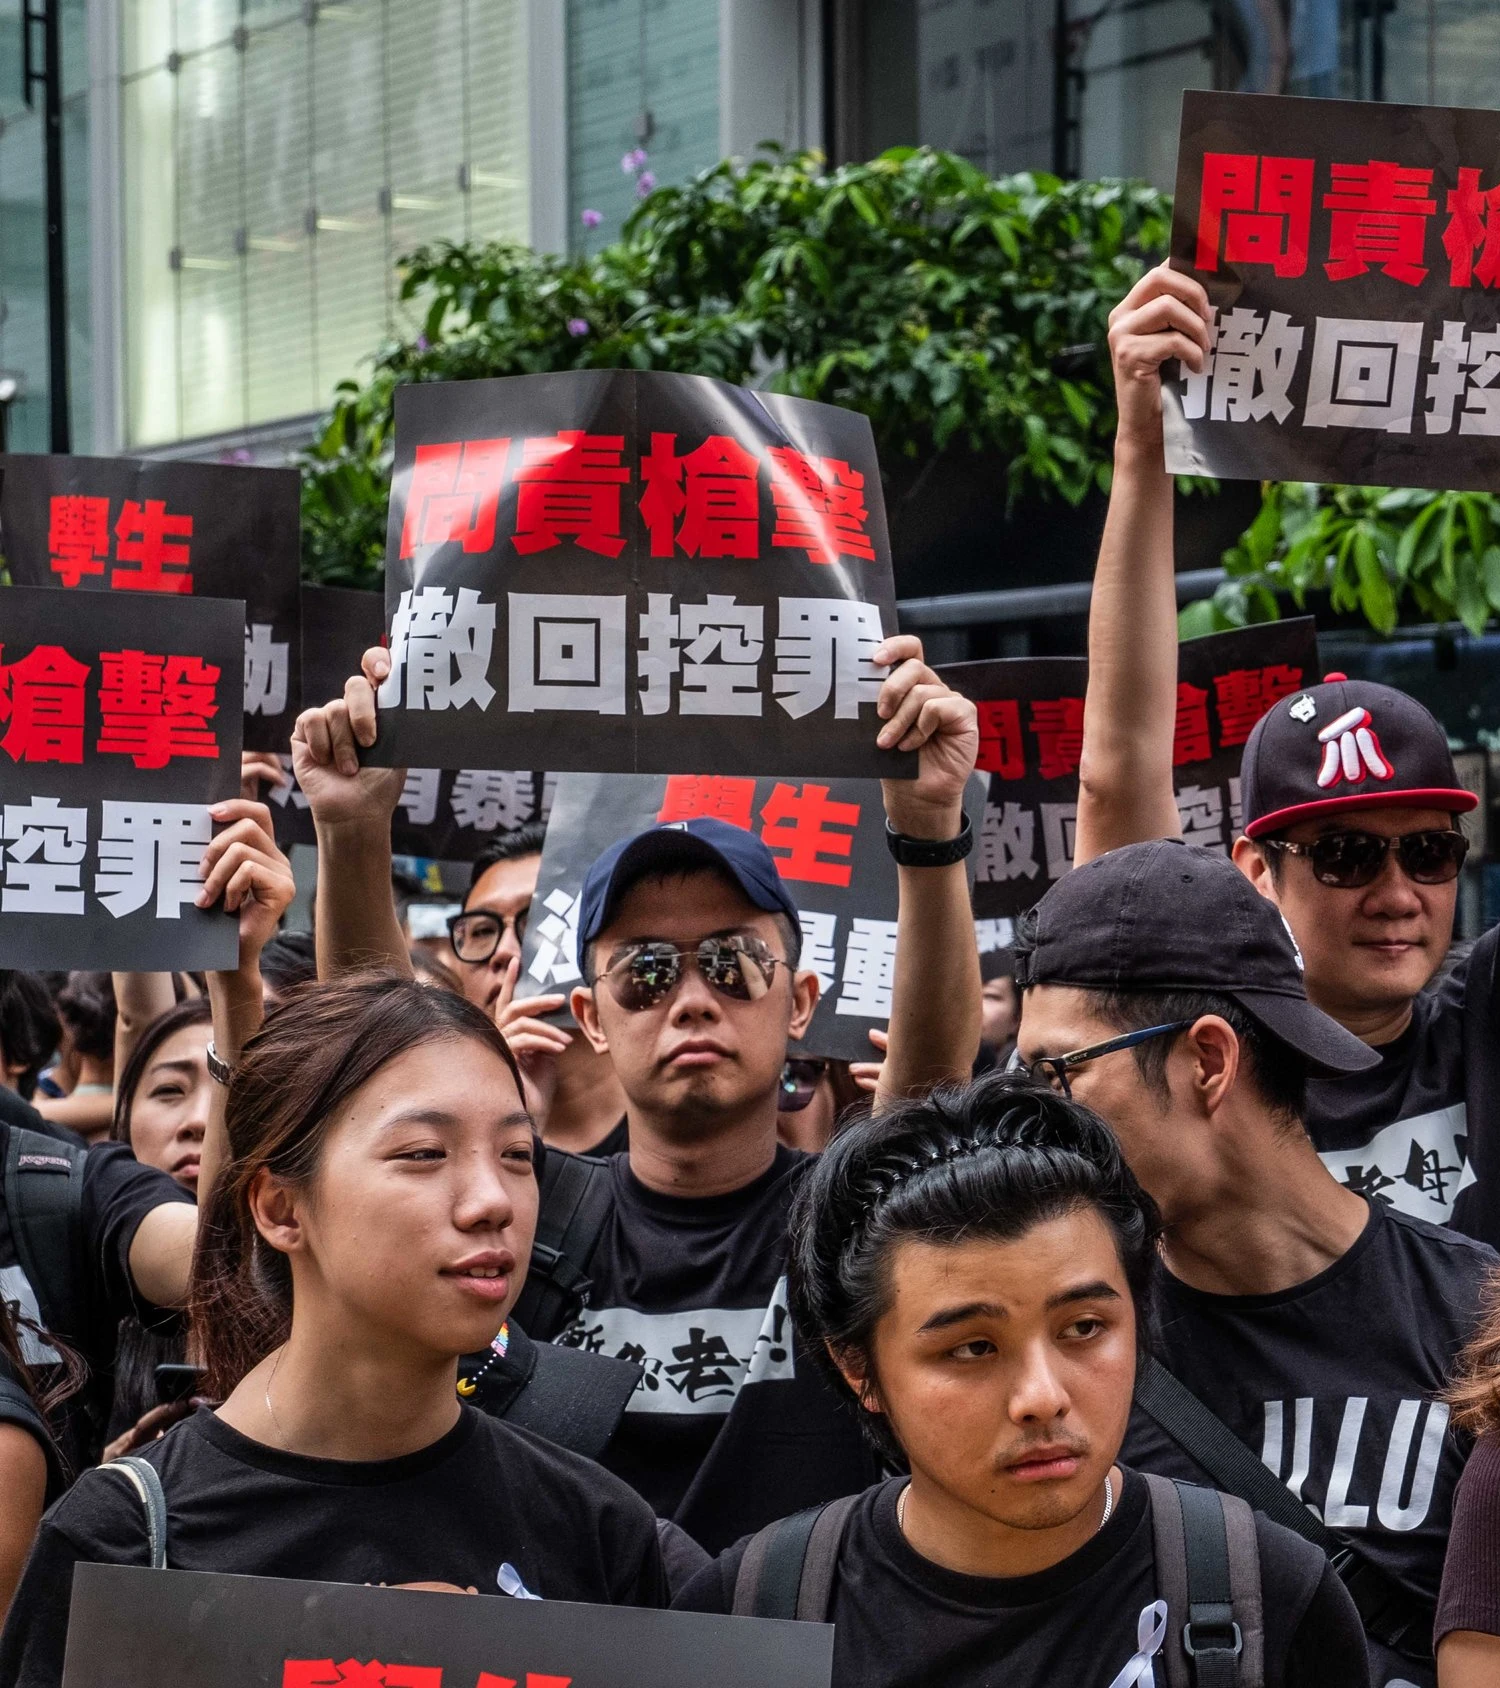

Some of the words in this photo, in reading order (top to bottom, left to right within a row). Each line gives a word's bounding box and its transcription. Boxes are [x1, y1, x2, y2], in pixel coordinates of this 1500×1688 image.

[48, 495, 193, 594] 學生
[399, 430, 876, 564] 問責槍擊
[0, 644, 220, 770] 槍擊
[377, 587, 889, 720] 撤回控罪
